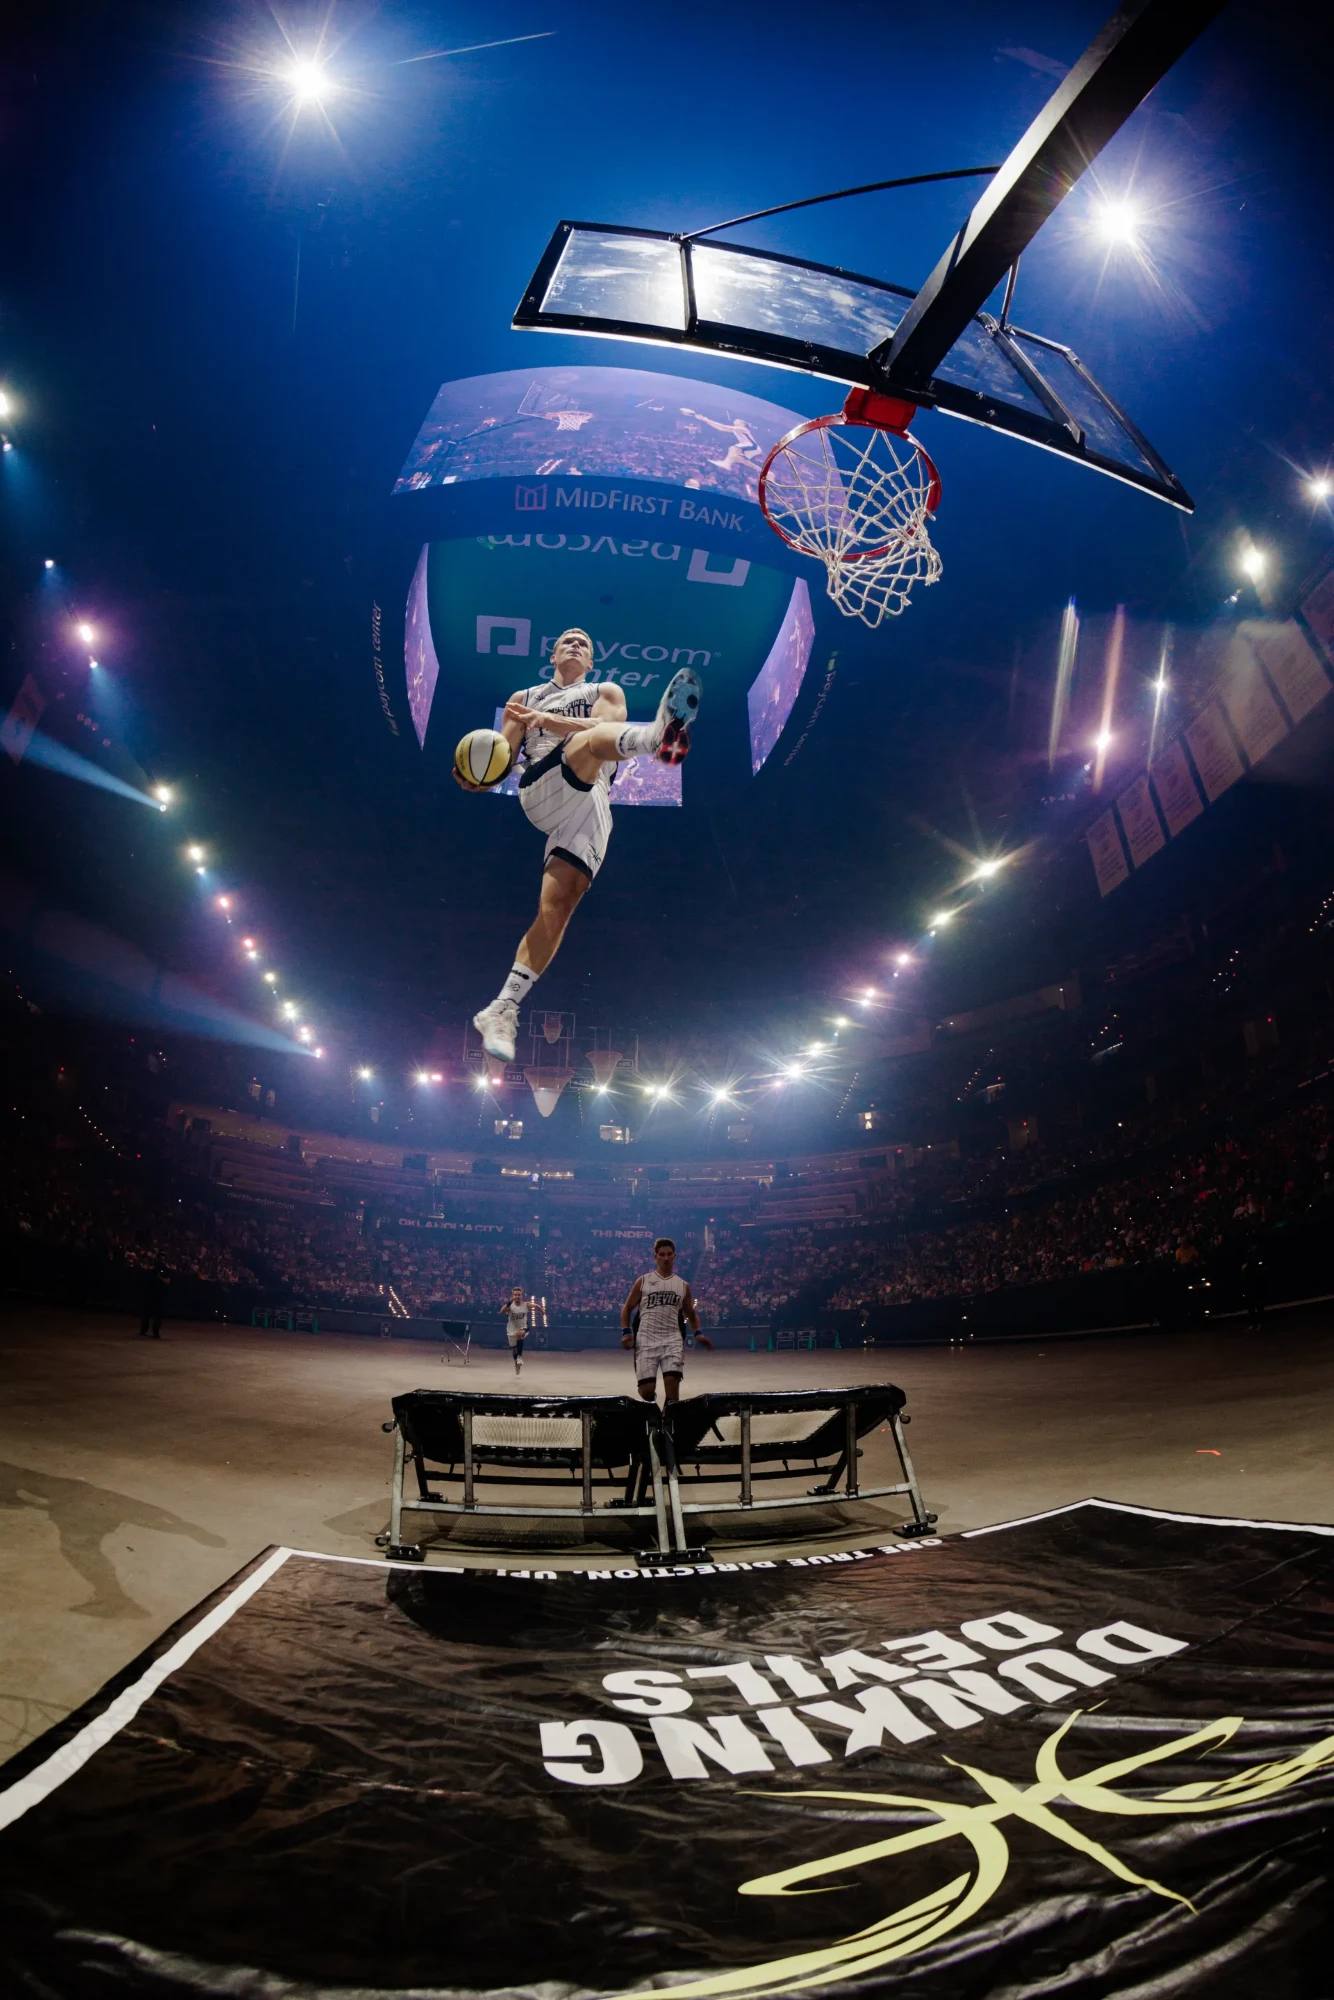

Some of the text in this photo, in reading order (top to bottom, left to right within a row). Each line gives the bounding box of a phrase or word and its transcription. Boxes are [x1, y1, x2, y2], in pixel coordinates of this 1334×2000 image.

[539, 635, 712, 667] pycom
[538, 664, 660, 688] cnter
[787, 1550, 874, 1567] TRUE
[878, 1538, 943, 1554] ONE
[602, 1610, 1063, 1715] DEVILS
[540, 1620, 1189, 1786] DUNKING
